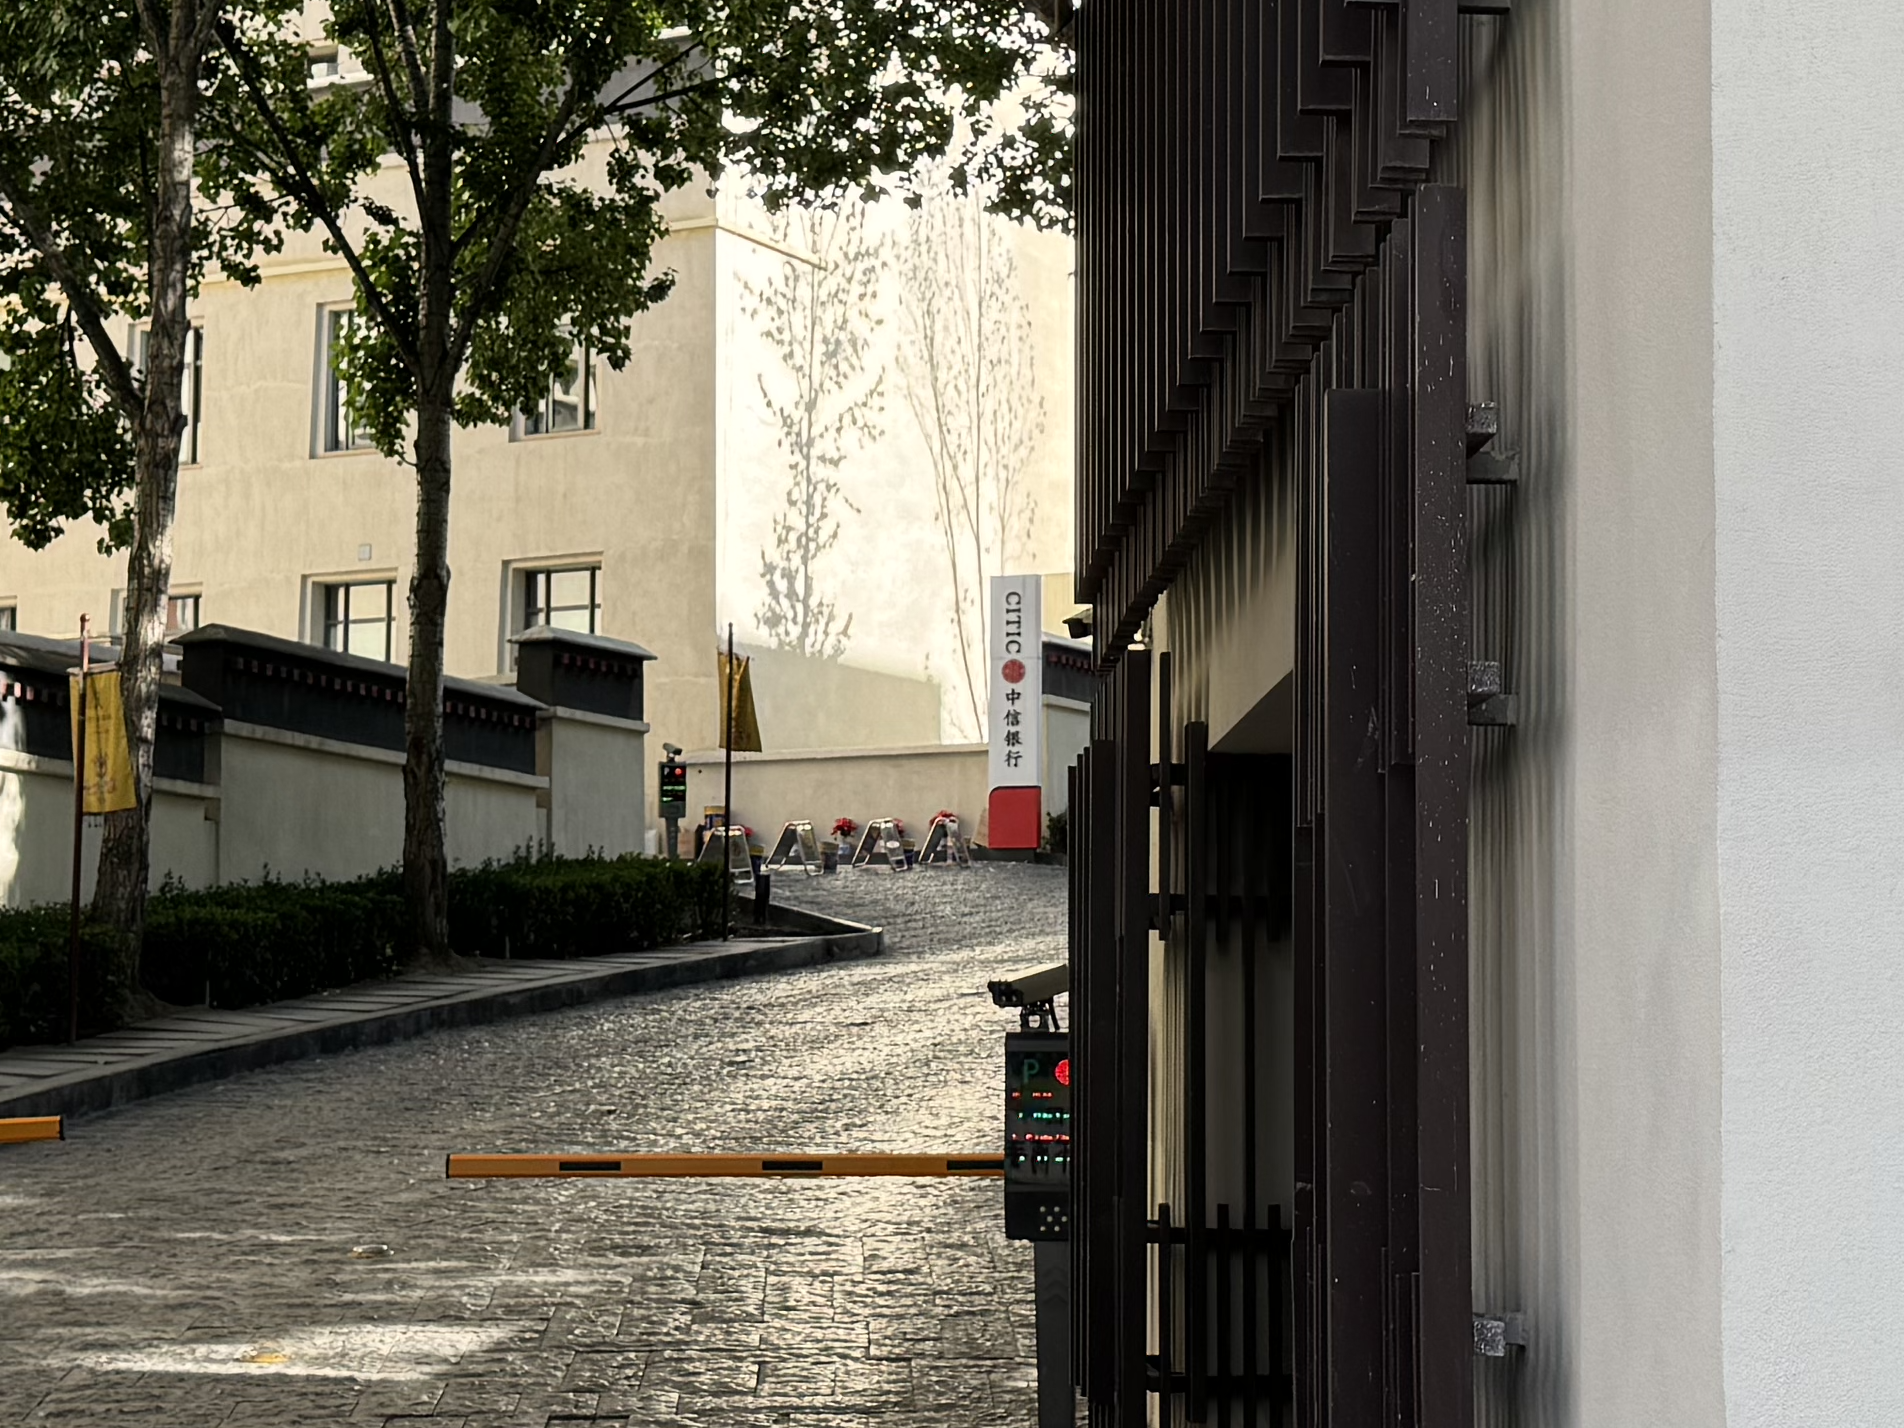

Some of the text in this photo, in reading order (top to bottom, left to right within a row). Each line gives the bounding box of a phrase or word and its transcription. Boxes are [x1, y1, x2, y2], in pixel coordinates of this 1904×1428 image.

[1005, 591, 1022, 654] CITIC
[1003, 688, 1023, 768] 中信银行
[1023, 1058, 1040, 1085] P
